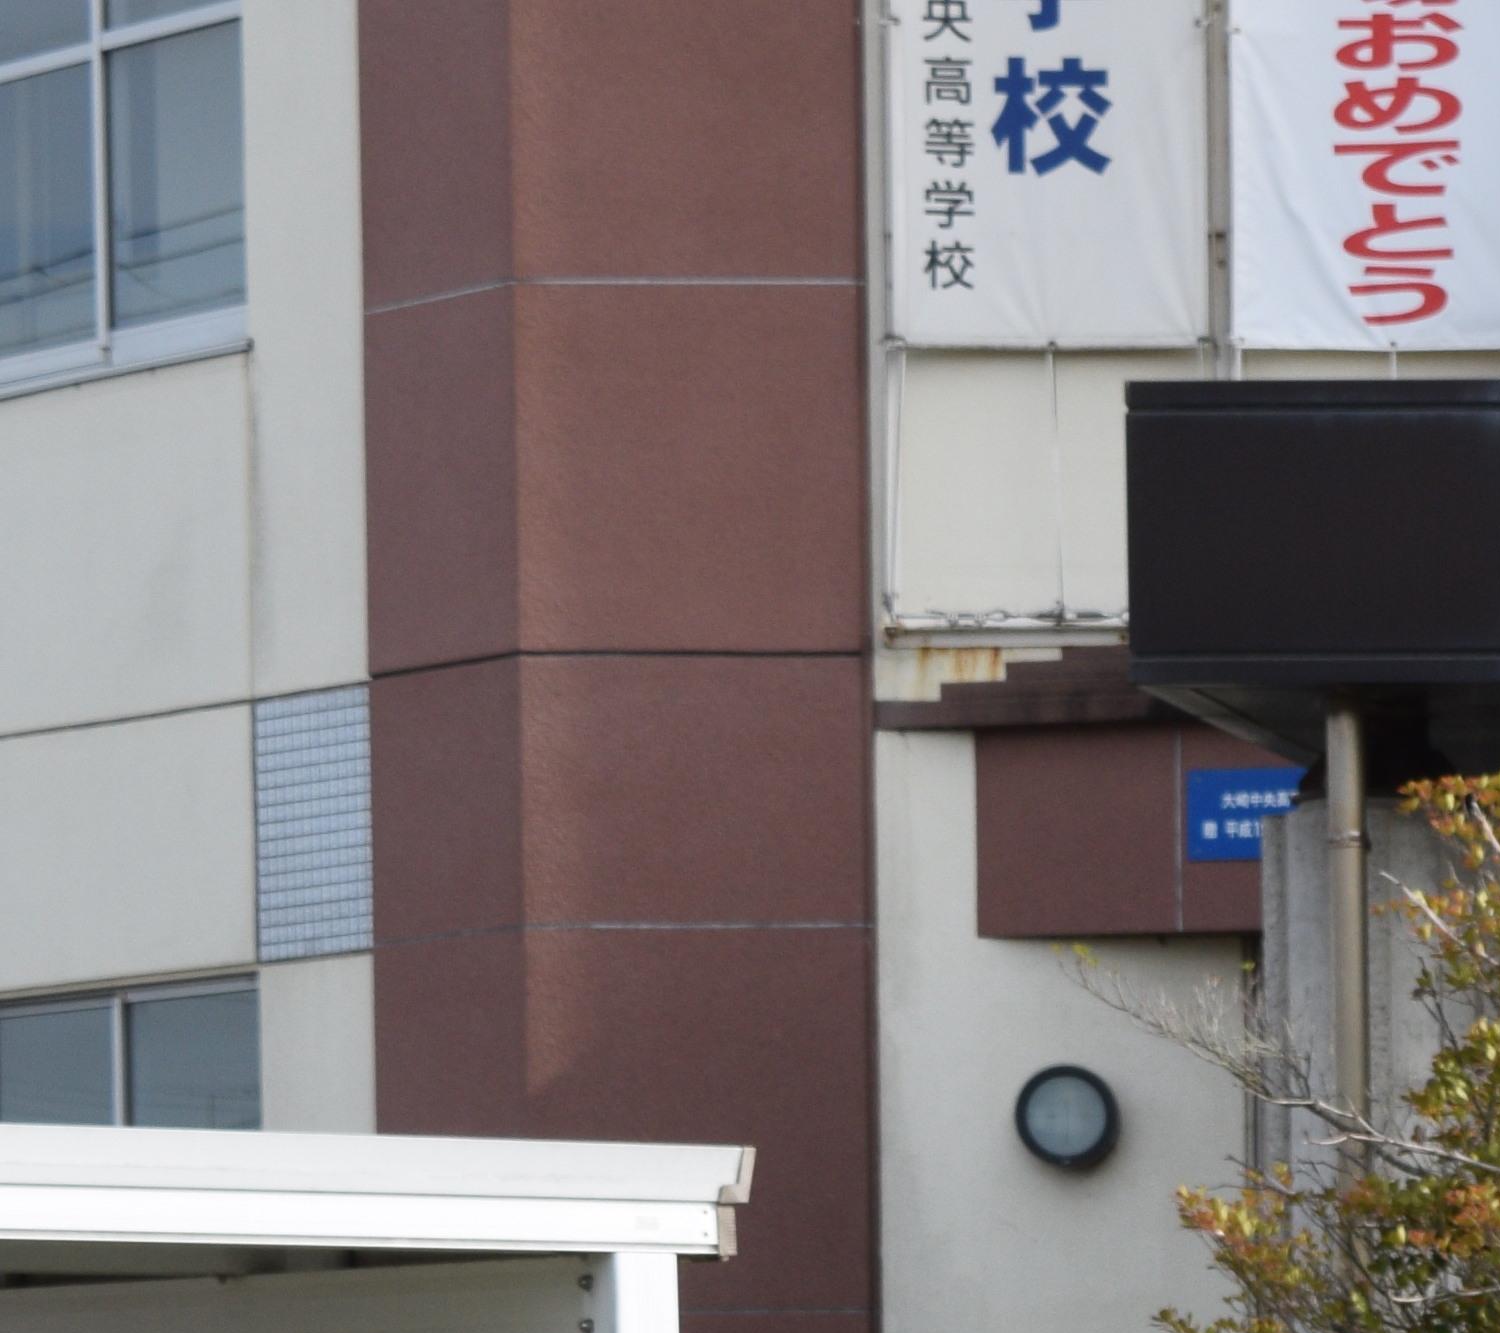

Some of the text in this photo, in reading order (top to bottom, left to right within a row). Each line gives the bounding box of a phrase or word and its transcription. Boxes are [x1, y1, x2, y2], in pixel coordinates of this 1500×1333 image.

[991, 0, 1113, 176] 校
[1333, 0, 1466, 328] おめでとう
[1221, 789, 1298, 809] 大崎中央高
